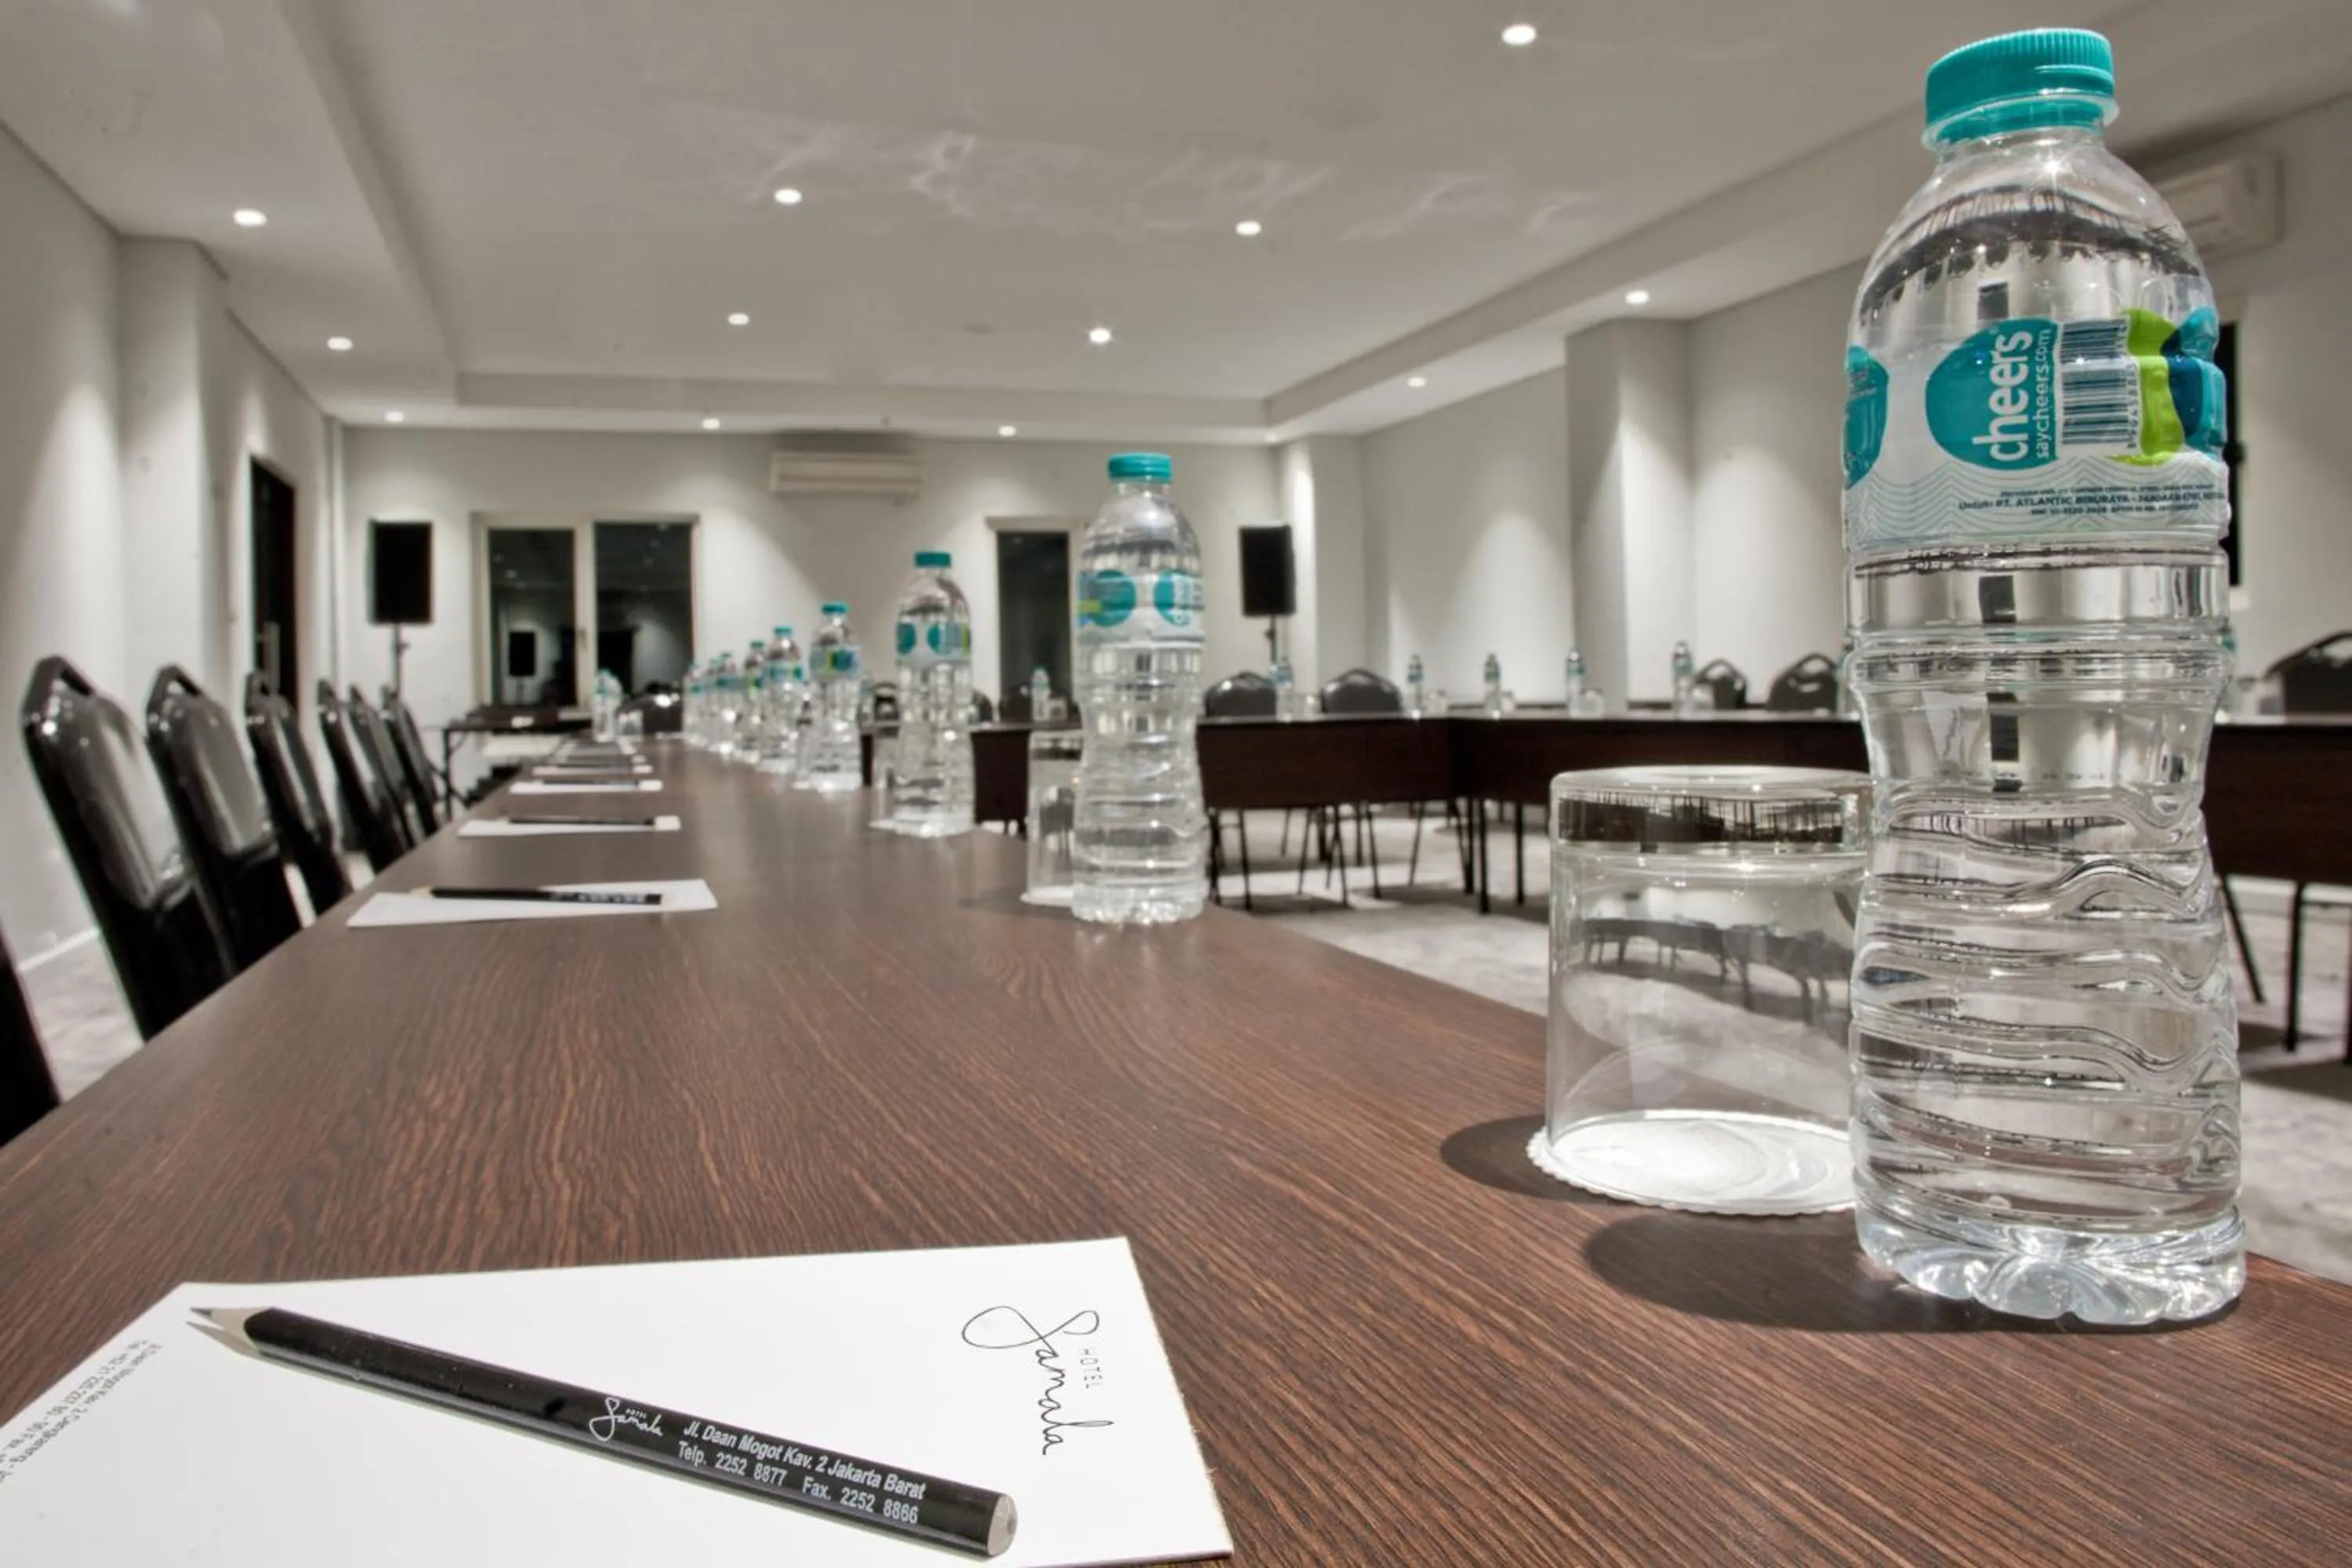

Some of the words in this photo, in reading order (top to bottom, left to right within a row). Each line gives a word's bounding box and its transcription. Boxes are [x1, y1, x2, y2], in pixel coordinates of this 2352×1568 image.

[1972, 330, 2033, 461] cheers
[2034, 328, 2052, 458] saycheers.com
[2016, 495, 2072, 507] ATLANTIC
[679, 1441, 706, 1466] Telp.
[715, 1452, 747, 1475] 2252
[753, 1463, 787, 1486] 8877
[803, 1476, 831, 1500] Fax.
[840, 1487, 876, 1512] 2252
[883, 1500, 919, 1524] 8866
[684, 1421, 699, 1437] Jl.
[702, 1425, 737, 1448] Daan
[738, 1435, 783, 1460] Mogot
[783, 1446, 811, 1469] Kav.
[815, 1455, 827, 1472] 2
[828, 1459, 882, 1488] Jakarta
[884, 1473, 926, 1500] Barat
